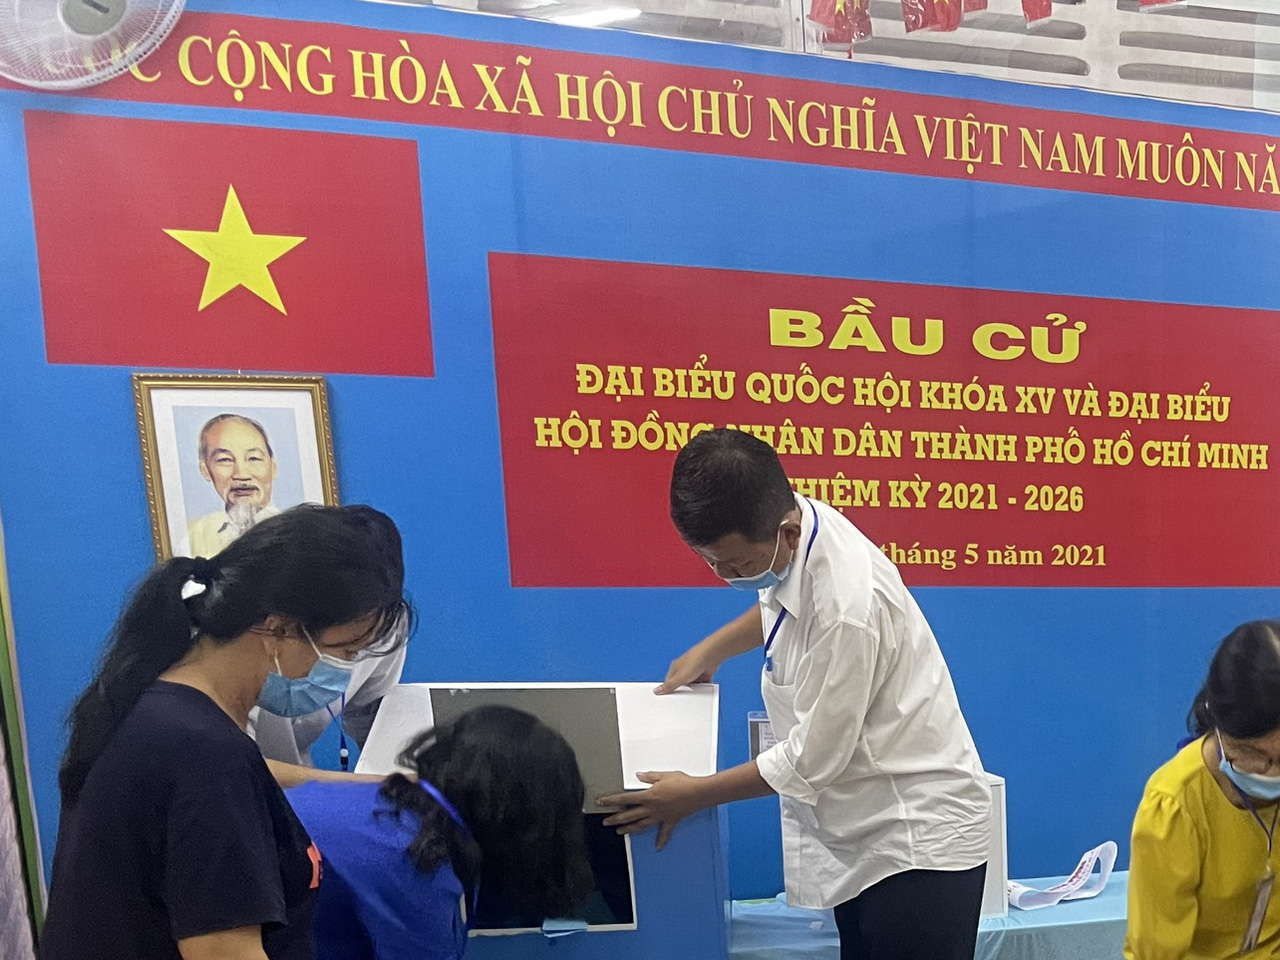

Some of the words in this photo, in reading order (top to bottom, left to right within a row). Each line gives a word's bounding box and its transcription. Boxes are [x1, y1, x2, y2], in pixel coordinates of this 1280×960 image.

[177, 29, 335, 102] CỘNG
[350, 39, 464, 109] HÒA
[473, 55, 543, 117] XÃ
[557, 70, 644, 138] HỘI
[657, 79, 753, 139] CHỦ
[767, 96, 907, 155] NGHĨA
[914, 113, 1009, 175] VIỆT
[1019, 127, 1105, 177] NAM
[1116, 132, 1225, 188] MUÔN
[768, 297, 944, 356] BẦU
[972, 312, 1087, 364] CỬ
[575, 363, 645, 402] ĐẠI
[652, 353, 736, 400] BIỂU
[745, 362, 845, 405] QUỐC
[852, 371, 912, 414] HỘI
[919, 375, 1008, 413] KHÓA
[1015, 385, 1056, 415] XV
[1062, 382, 1102, 417] VÀ
[1108, 391, 1160, 425] ĐẠI
[1166, 382, 1231, 422] BIỂU
[533, 410, 603, 455] HỘI
[832, 421, 903, 458] DÂN
[910, 425, 1018, 462] THÀNH
[1025, 426, 1086, 464] PHỐ
[1092, 429, 1134, 466] HỒ
[1141, 434, 1191, 468] CHÍ
[1197, 442, 1269, 470] MINH
[787, 471, 881, 512] HIỆM
[888, 473, 932, 508] KỲ
[937, 482, 998, 510] 2021
[1024, 484, 1084, 512] 2026
[964, 543, 979, 565] 5
[987, 544, 1043, 565] năm
[1051, 544, 1105, 566] 2021
